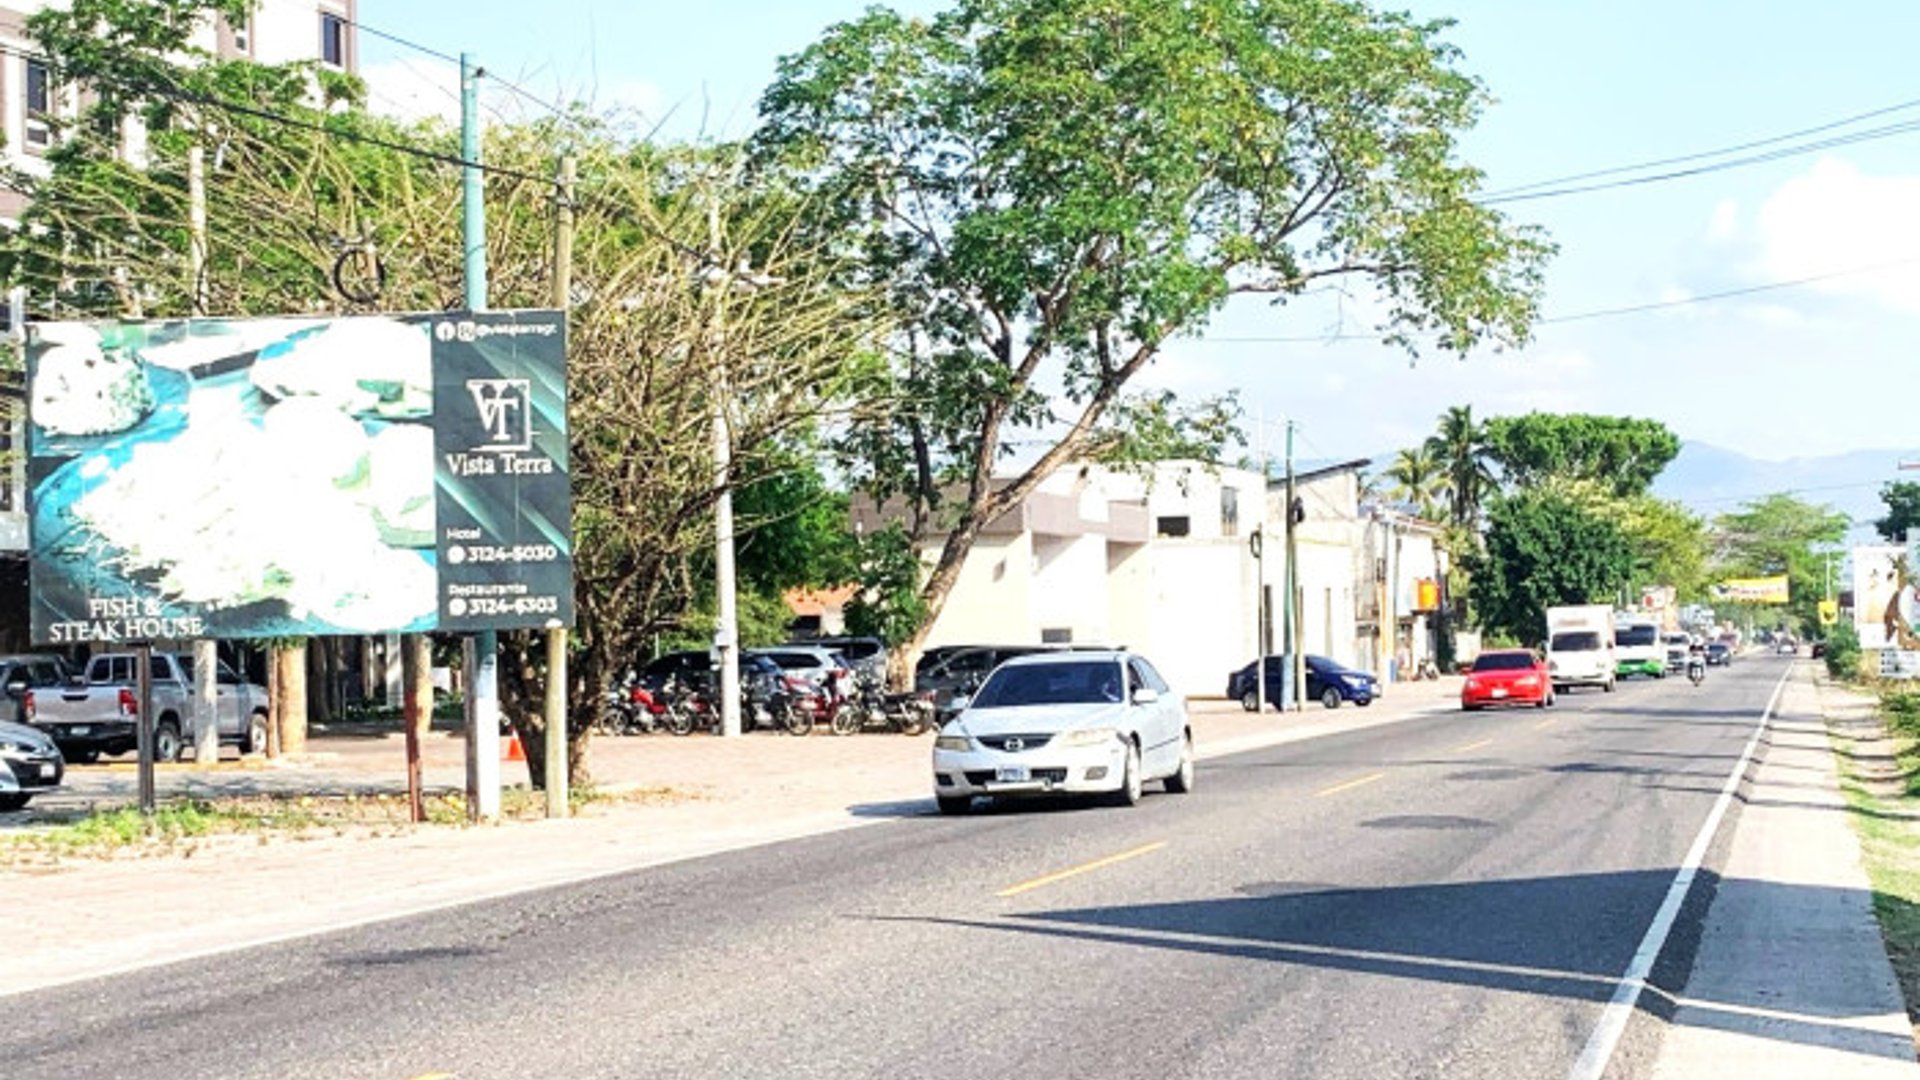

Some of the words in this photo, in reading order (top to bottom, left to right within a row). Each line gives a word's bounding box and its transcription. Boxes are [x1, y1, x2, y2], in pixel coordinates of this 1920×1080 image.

[446, 453, 496, 476] Vista
[499, 453, 553, 474] Terra
[89, 597, 139, 619] FISH
[143, 597, 162, 616] &
[468, 596, 558, 616] 3124-6303
[50, 620, 121, 643] STEAK
[125, 617, 205, 638] HOUSE
